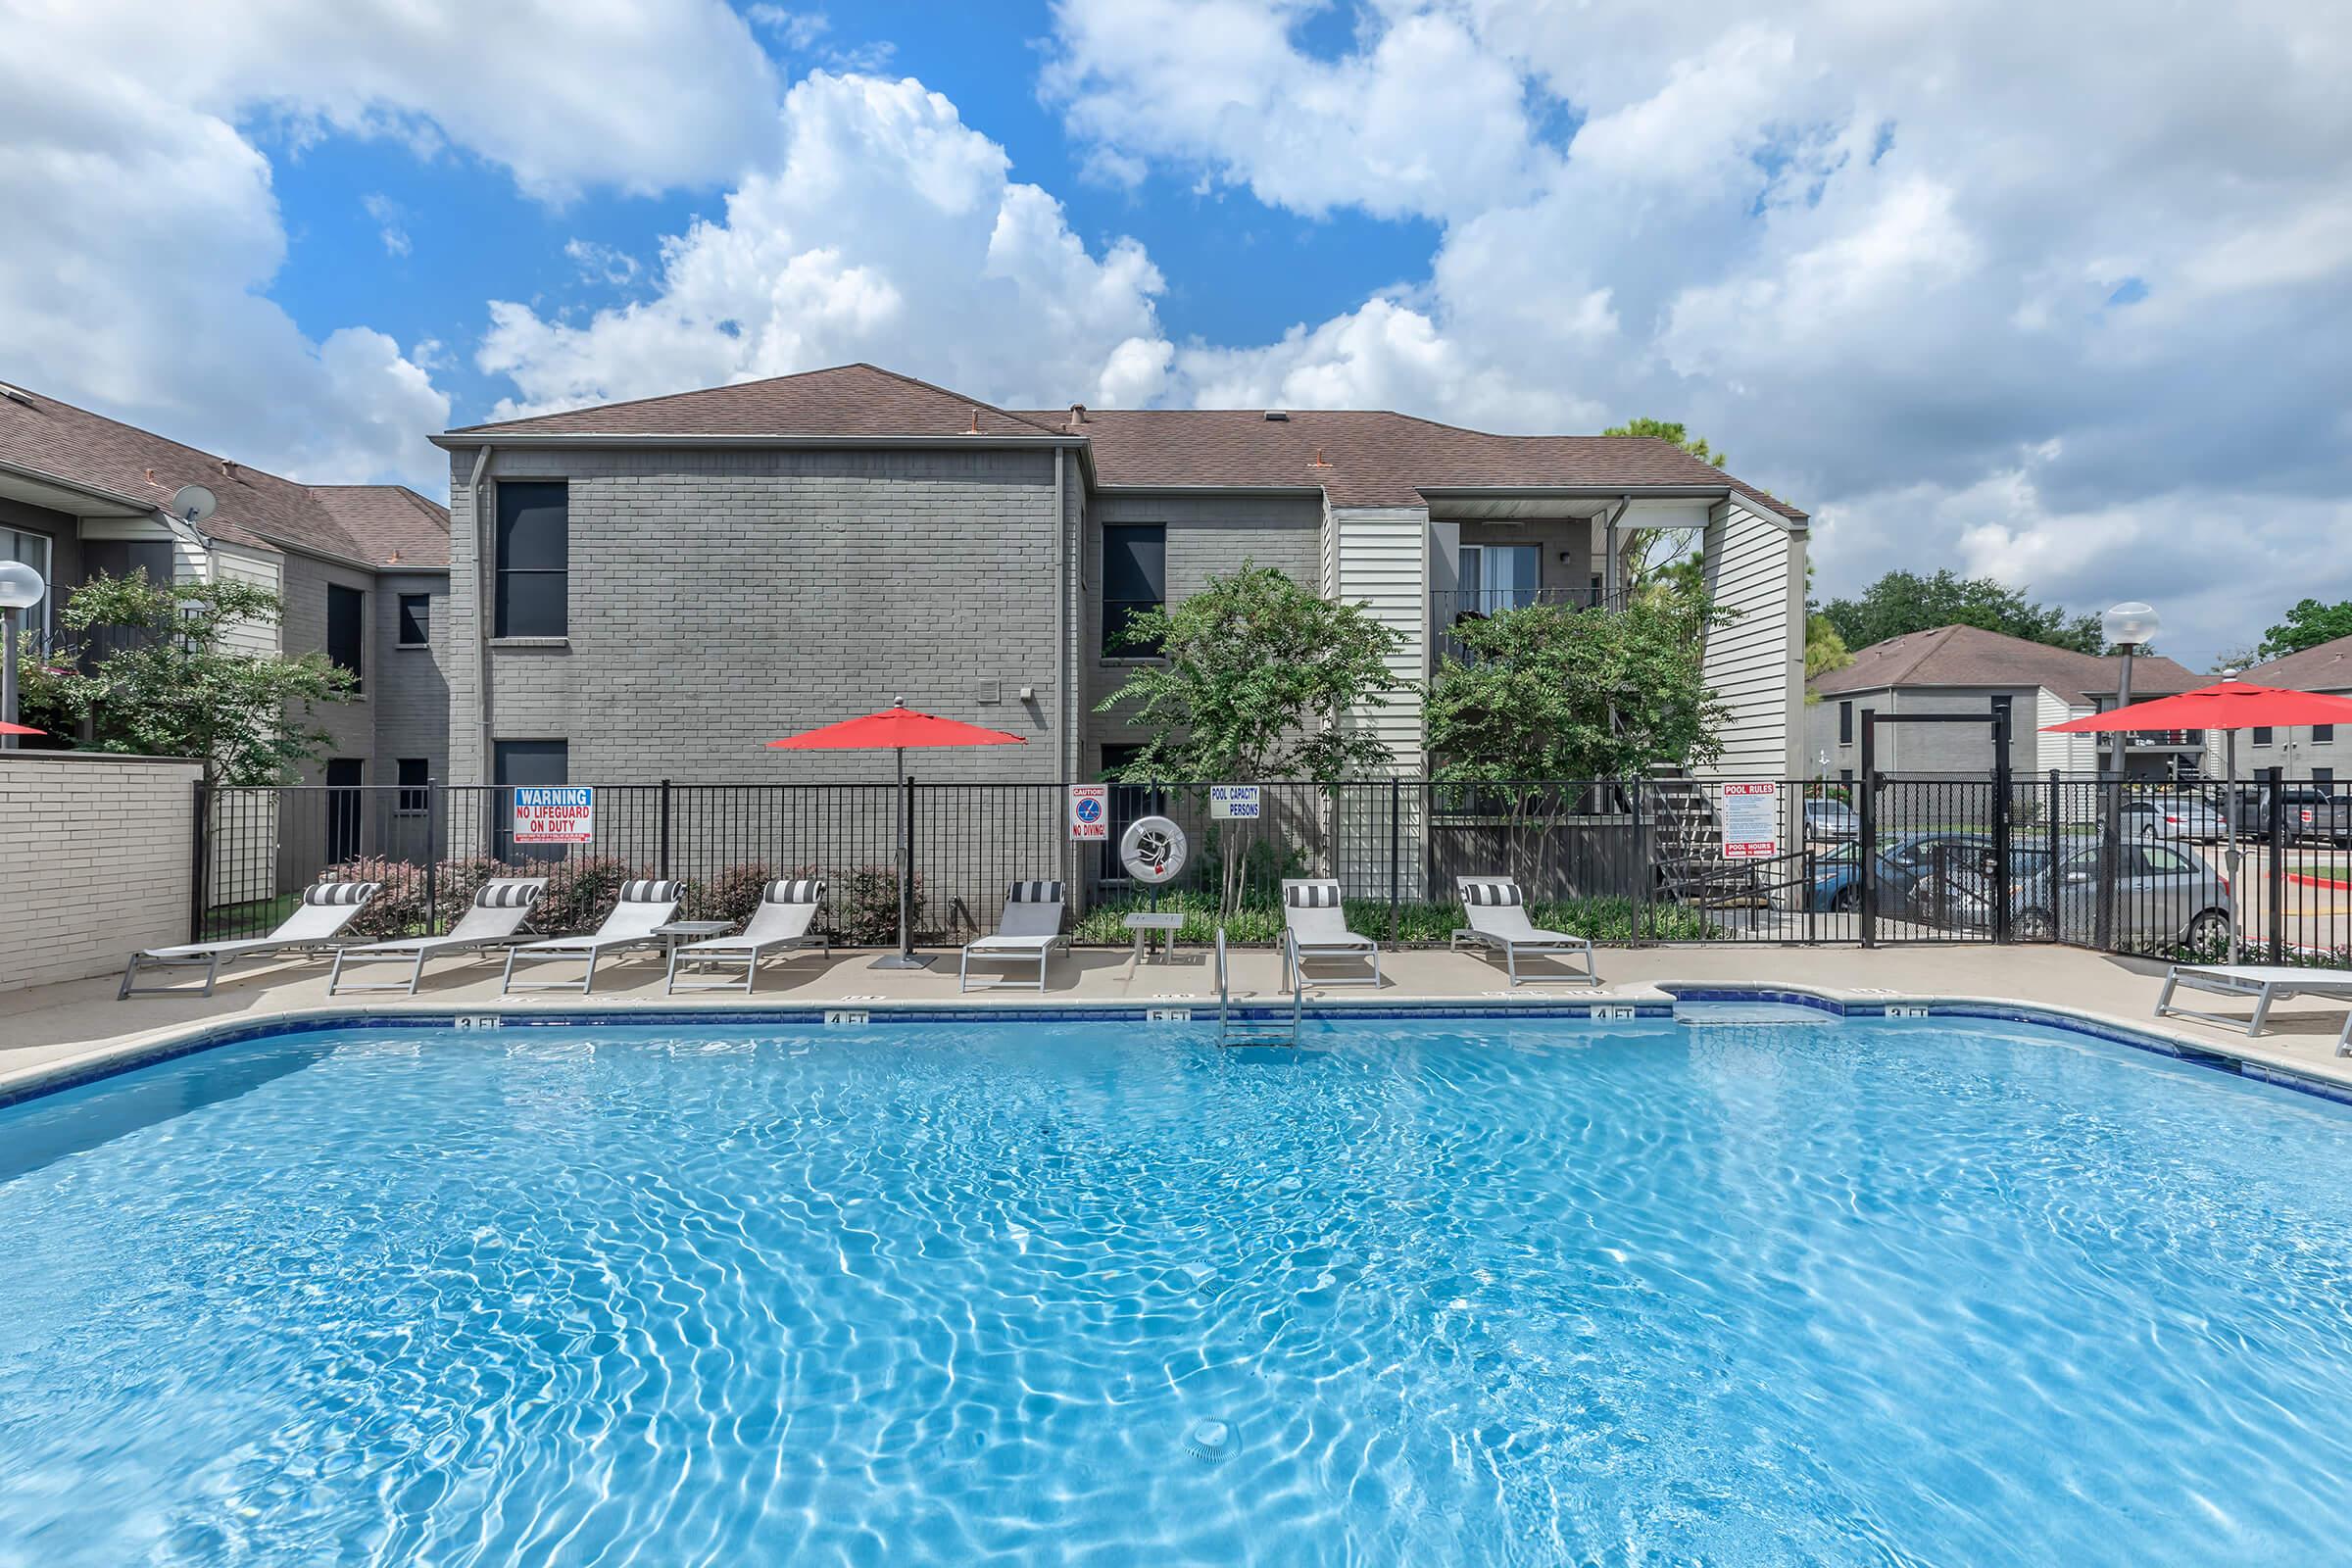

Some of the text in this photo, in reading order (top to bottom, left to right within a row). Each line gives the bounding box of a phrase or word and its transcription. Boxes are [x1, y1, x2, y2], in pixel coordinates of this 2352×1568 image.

[1212, 787, 1258, 800] POOL CAPACITY
[1749, 784, 1773, 793] RULES
[521, 790, 587, 806] WARNING
[516, 807, 590, 818] NO LIFEGUARD
[1230, 804, 1258, 816] PERSONS
[530, 820, 575, 832] ON DUTY
[1073, 824, 1104, 836] NO DIVING!
[830, 1012, 867, 1023] 4 FT
[1152, 1010, 1190, 1020] 5 FT
[1597, 1007, 1633, 1019] 4 FT
[479, 1017, 497, 1027] FT
